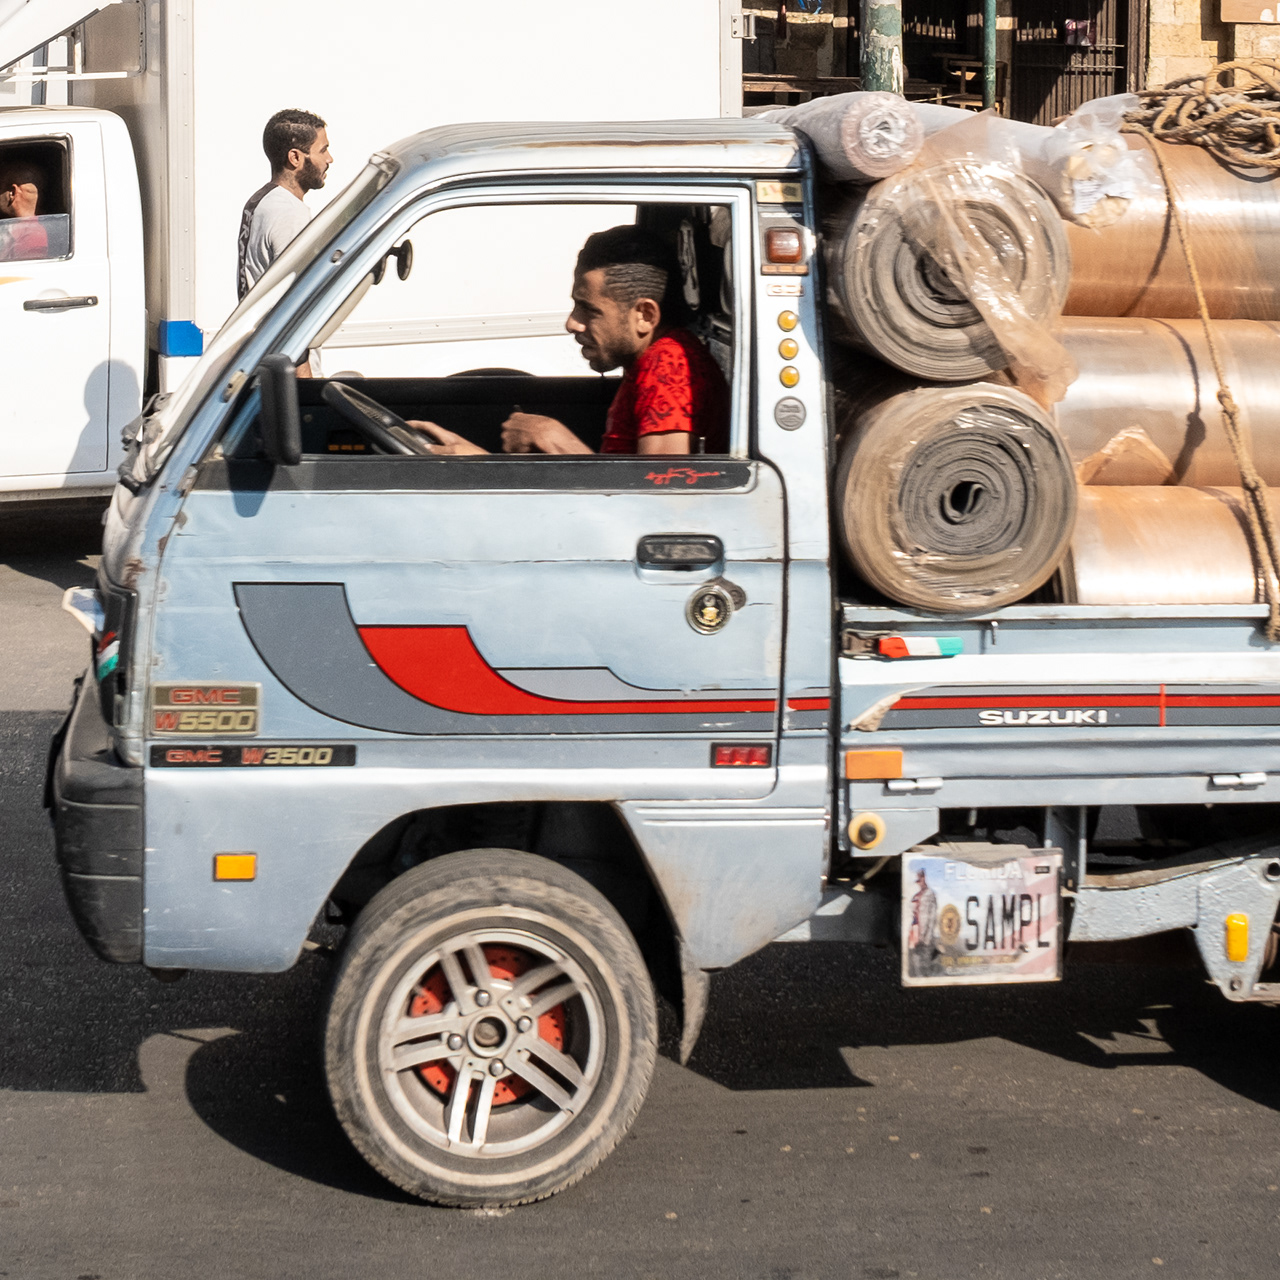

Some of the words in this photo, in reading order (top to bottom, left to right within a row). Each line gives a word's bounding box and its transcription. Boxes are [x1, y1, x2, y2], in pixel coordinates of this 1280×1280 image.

[170, 688, 241, 705] GMC
[154, 711, 255, 731] W5500
[978, 709, 1108, 725] SUZUKI
[165, 749, 223, 763] GMC
[241, 747, 333, 765] W3500
[965, 893, 1050, 951] SAMPL
